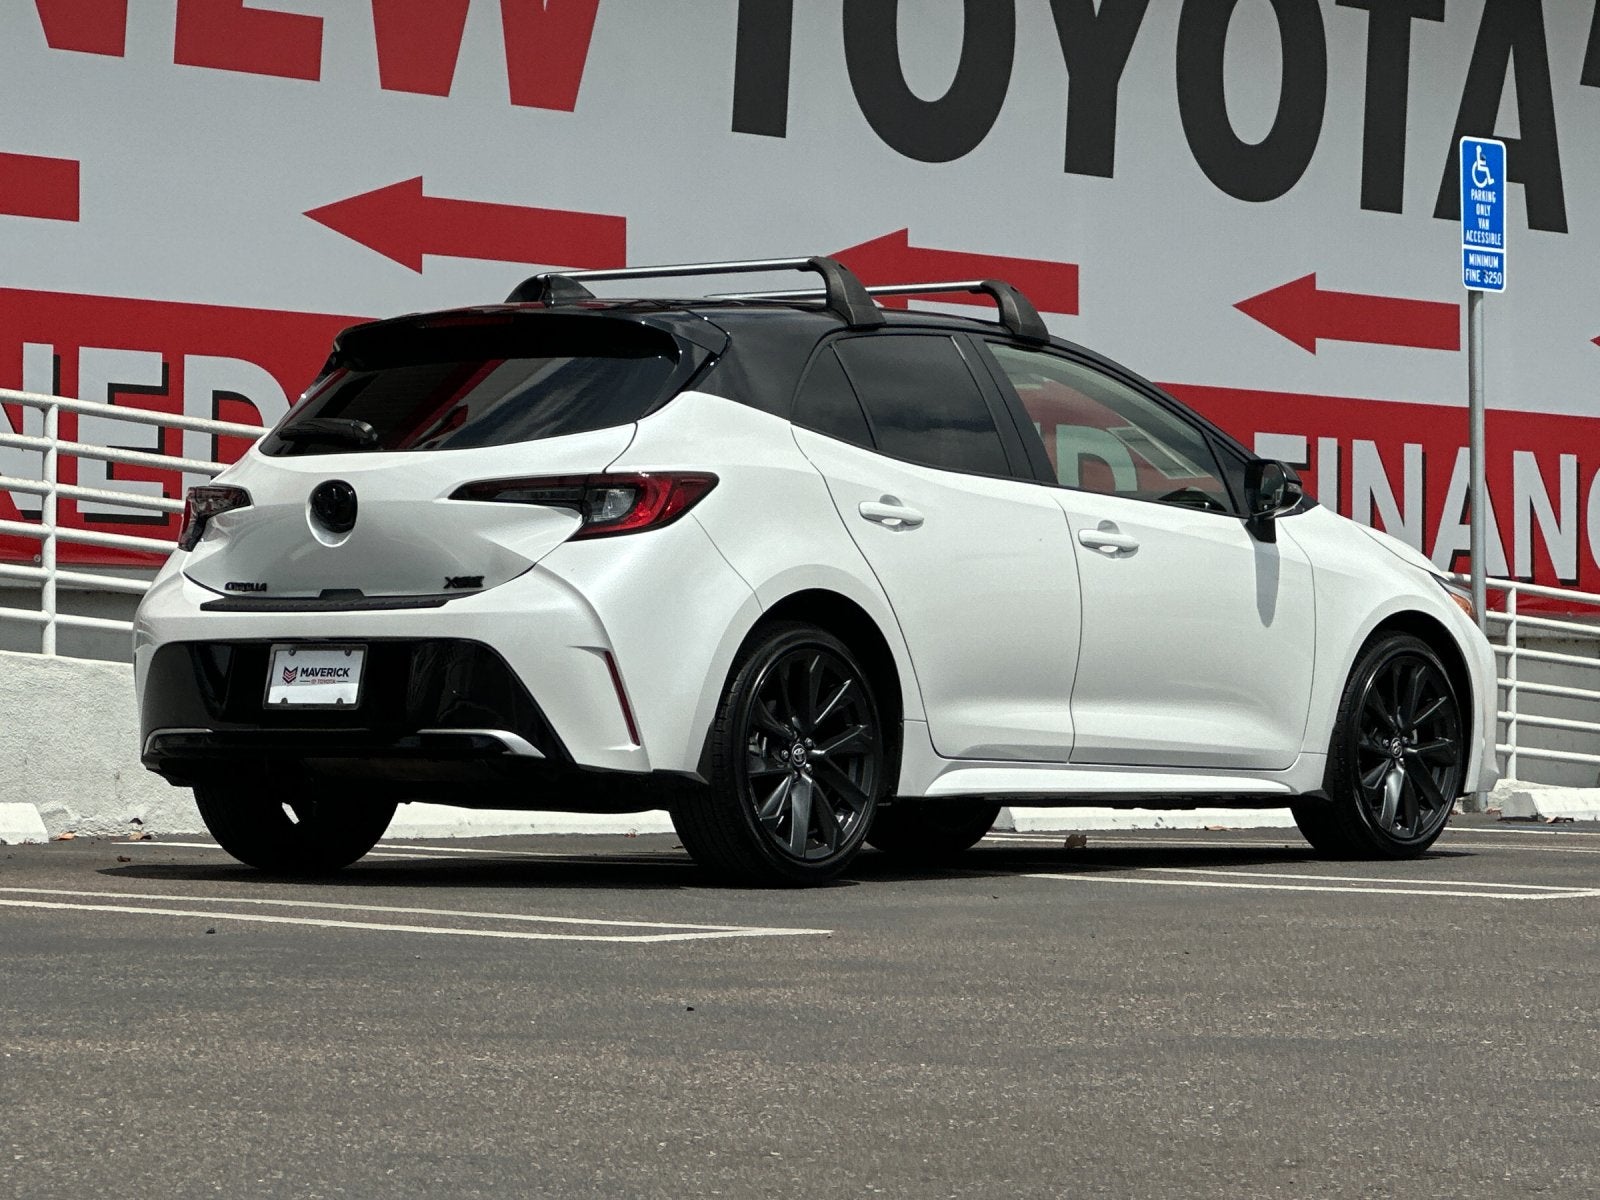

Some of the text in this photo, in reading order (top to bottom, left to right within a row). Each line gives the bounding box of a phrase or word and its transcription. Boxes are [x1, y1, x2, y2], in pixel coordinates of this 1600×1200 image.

[1470, 188, 1496, 204] PARKING
[1475, 203, 1491, 217] ONLY
[1477, 217, 1490, 230] VAN
[1466, 229, 1502, 246] ACCESSIBLE
[1468, 253, 1499, 269] MINIMUM
[1465, 268, 1502, 285] FINE $250
[1254, 432, 1600, 582] INAN
[300, 667, 350, 678] MAVERICK
